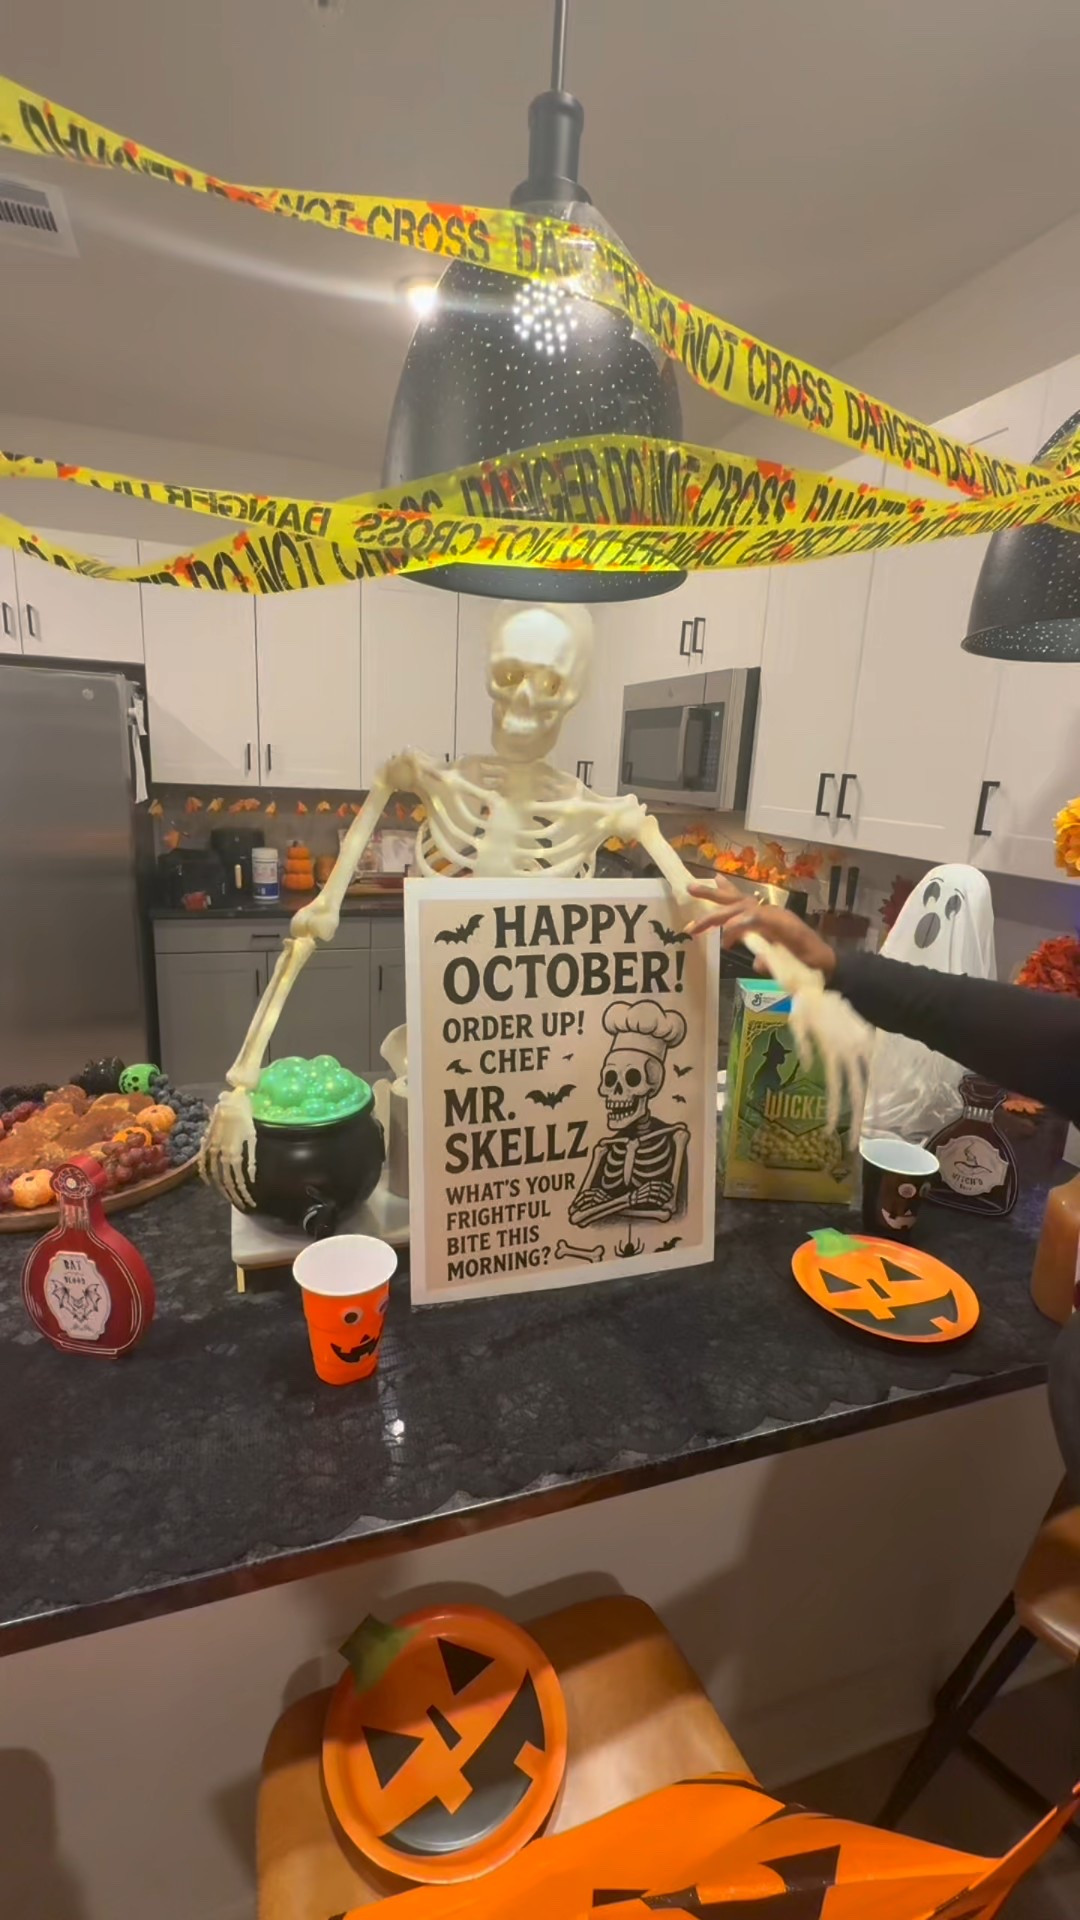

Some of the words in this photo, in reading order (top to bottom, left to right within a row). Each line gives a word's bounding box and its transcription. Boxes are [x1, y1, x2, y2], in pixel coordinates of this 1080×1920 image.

[367, 205, 491, 264] CROSS
[682, 312, 738, 391] NOT
[748, 343, 833, 418] CROSS
[844, 390, 941, 477] DANGER
[938, 437, 977, 486] DO
[975, 452, 1019, 498] NOT
[460, 448, 611, 526] DANGER
[603, 446, 652, 526] DO
[698, 463, 796, 526] CROSS
[244, 531, 325, 595] NOT
[493, 903, 648, 949] HAPPY
[443, 951, 686, 1004] OCTOBER!
[443, 1012, 534, 1043] ORDER
[542, 1010, 585, 1037] UP!
[479, 1046, 551, 1075] CHEF
[444, 1085, 517, 1128] MR.
[765, 1092, 828, 1124] WICKE
[445, 1121, 589, 1175] SKELLZ
[446, 1178, 521, 1206] WHAT'S
[525, 1172, 576, 1195] YOUR
[446, 1199, 551, 1231] FRIGHTFUL
[447, 1233, 491, 1256] BITE
[496, 1225, 540, 1249] THIS
[447, 1246, 552, 1281] MORNING?
